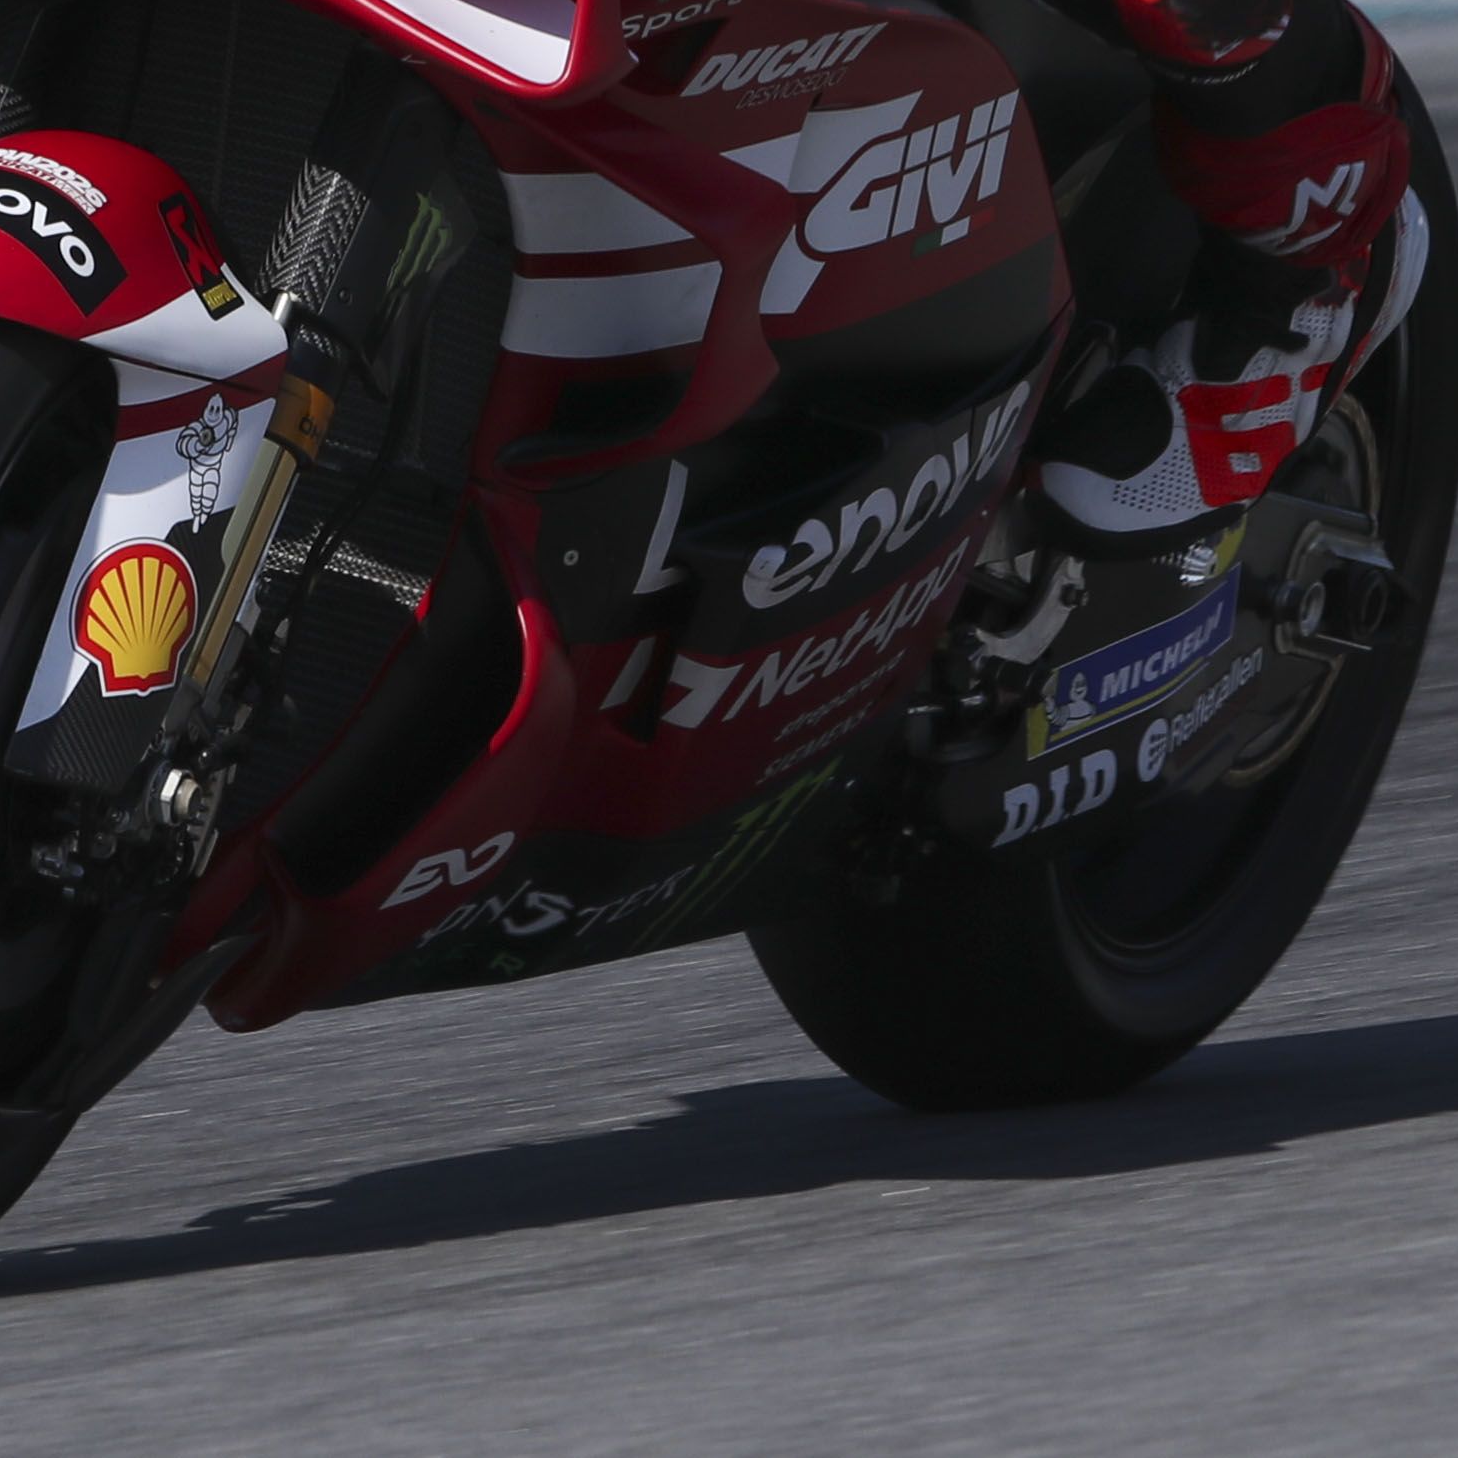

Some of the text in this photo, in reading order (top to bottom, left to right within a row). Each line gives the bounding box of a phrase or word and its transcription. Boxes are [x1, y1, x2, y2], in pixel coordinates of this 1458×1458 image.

[679, 21, 890, 98] DUCATI
[802, 87, 1021, 255] GIVI
[632, 380, 1031, 610] Lenovo
[721, 536, 971, 723] NetApp
[1098, 600, 1224, 703] MICHELIN
